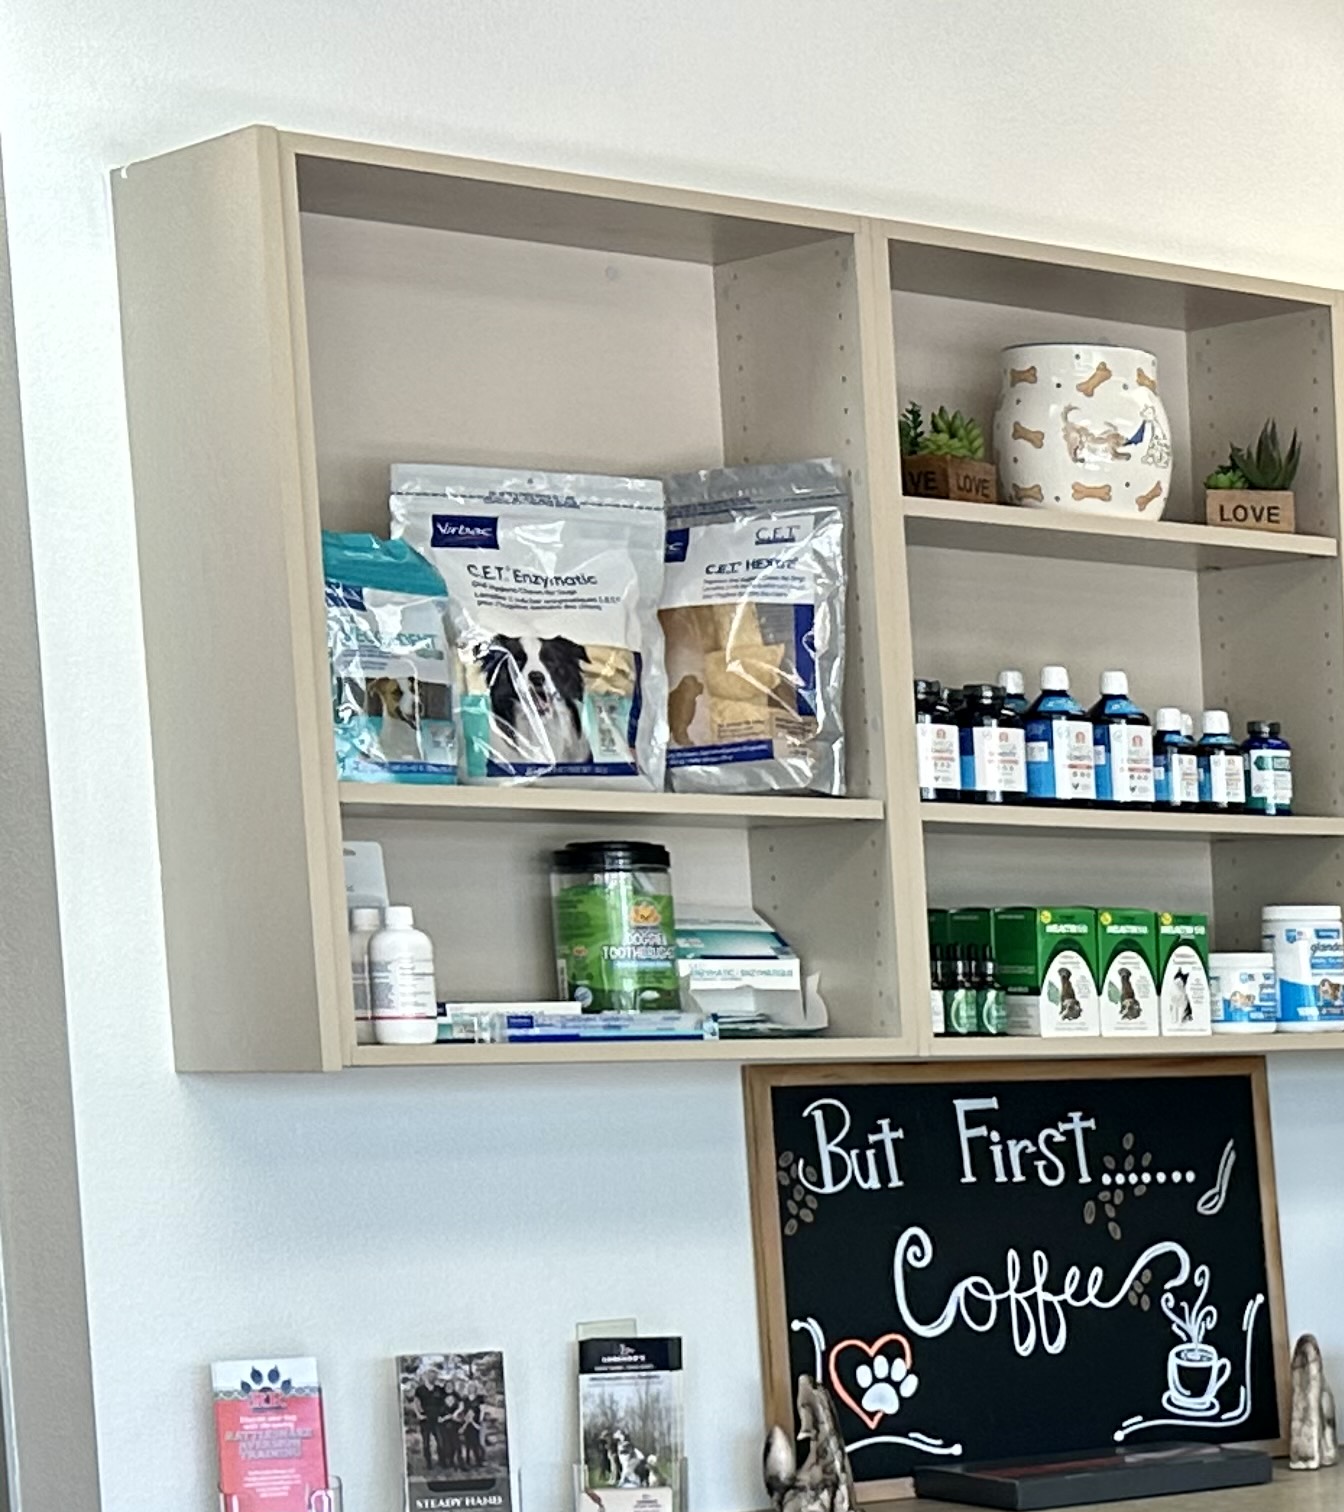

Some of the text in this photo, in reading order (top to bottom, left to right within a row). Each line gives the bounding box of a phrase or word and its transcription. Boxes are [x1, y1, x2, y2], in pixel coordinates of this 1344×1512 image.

[907, 470, 938, 492] VE
[956, 471, 991, 499] LOVE
[1218, 503, 1281, 526] LOVE
[436, 521, 493, 537] Virbac
[513, 568, 598, 588] Enzymatic
[798, 1098, 904, 1194] But
[893, 1226, 1191, 1356] Coffee
[416, 1495, 503, 1508] STEADY HAND
